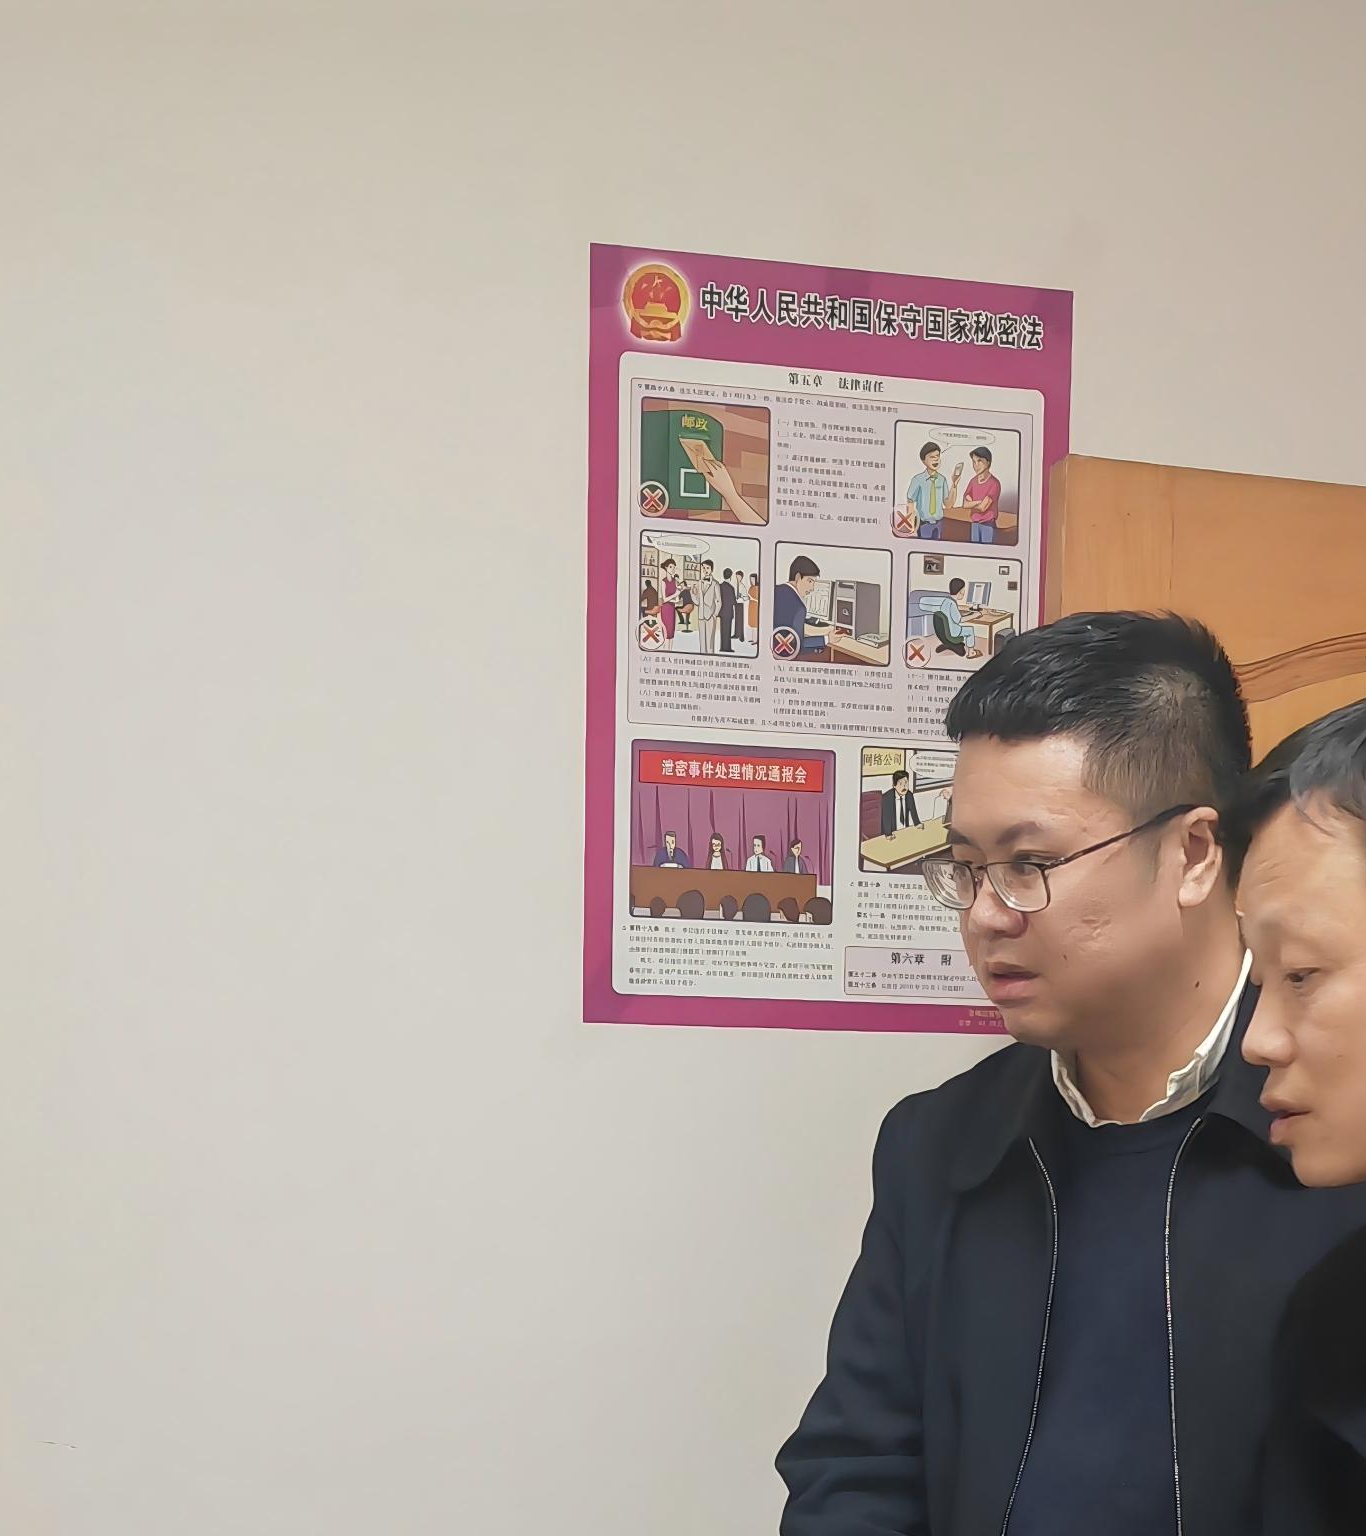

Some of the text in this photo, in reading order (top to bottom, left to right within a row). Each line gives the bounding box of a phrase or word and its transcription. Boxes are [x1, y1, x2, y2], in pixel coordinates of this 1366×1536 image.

[700, 282, 1044, 350] 中华人民共和国保守国家秘密法
[864, 753, 902, 767] 网络公司
[662, 758, 808, 785] 泄密事件处理情况通报会
[891, 952, 925, 966] 第六章
